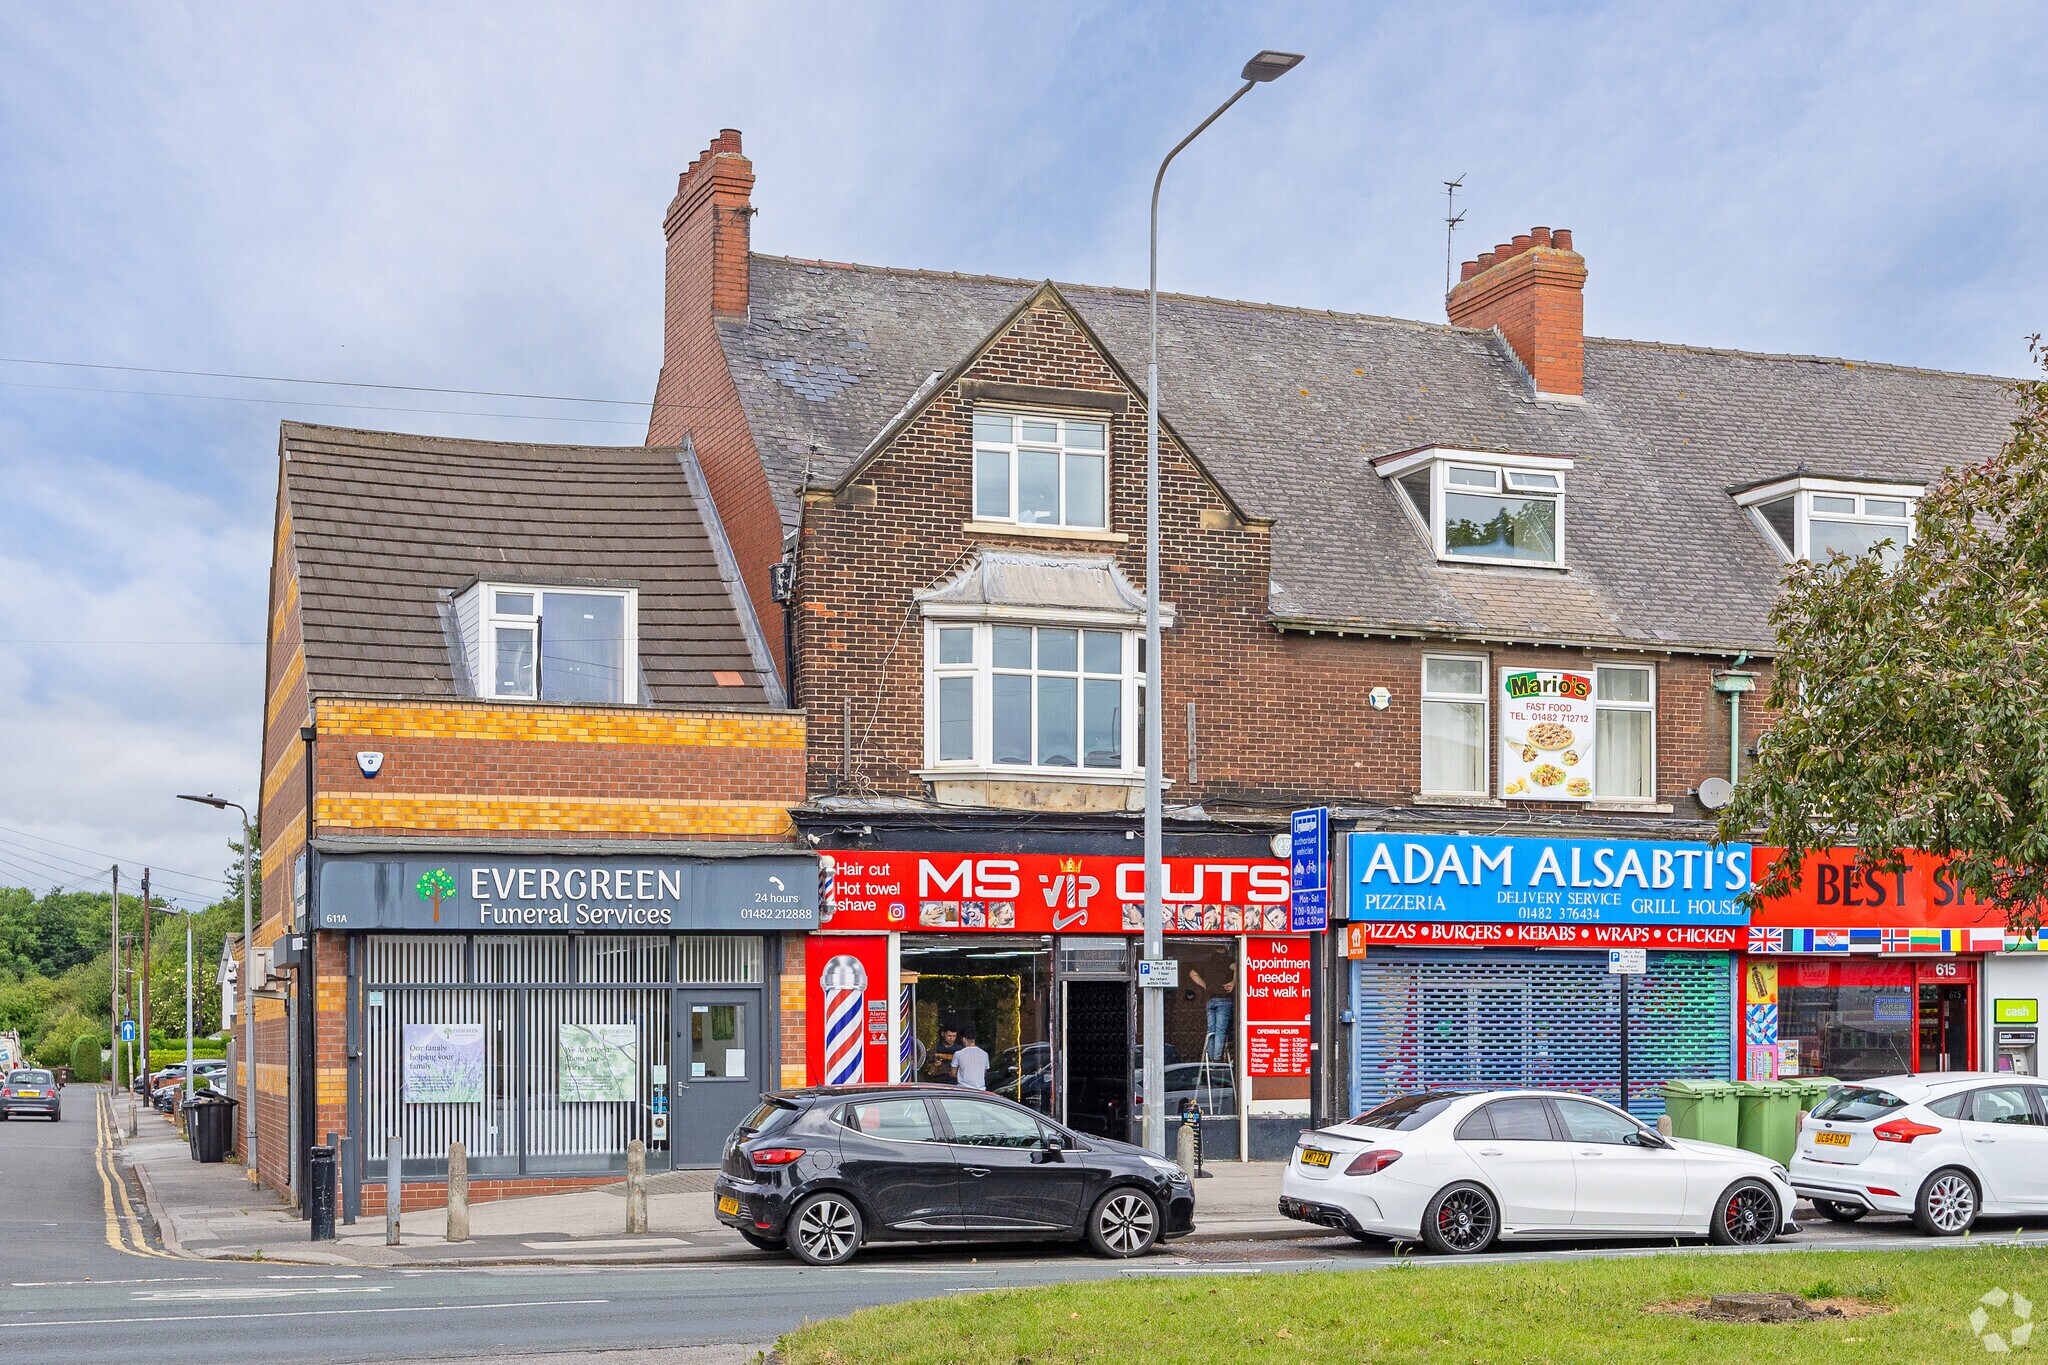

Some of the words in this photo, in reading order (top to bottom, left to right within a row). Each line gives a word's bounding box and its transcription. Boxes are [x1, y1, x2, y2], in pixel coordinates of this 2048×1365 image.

[1510, 675, 1587, 697] Mario's
[1525, 703, 1546, 711] FAST
[1548, 703, 1572, 712] FOOD
[1510, 712, 1529, 720] TEL:
[1532, 713, 1557, 722] 01482
[1561, 714, 1589, 723] 712712
[1294, 836, 1317, 846] authorised
[1296, 847, 1314, 856] vehicles
[836, 862, 864, 876] Hair
[869, 863, 890, 876] cut
[1361, 842, 1514, 886] ADAM
[1529, 847, 1748, 890] ALSABTI'S
[470, 867, 681, 900] EVERGREEN
[836, 881, 860, 895] Hot
[865, 882, 900, 895] towel
[918, 858, 1021, 899] MS
[1038, 874, 1100, 908] VIP
[1116, 862, 1291, 901] CUTS
[1294, 877, 1303, 887] taxi
[1817, 864, 1913, 907] BEST
[755, 893, 767, 903] 24
[769, 892, 799, 903] hours
[1497, 890, 1561, 905] DELIVERY
[1567, 891, 1622, 906] SERVICE
[837, 898, 877, 911] shave
[1365, 893, 1446, 912] PIZZERIA
[1631, 898, 1681, 915] GRILL
[1688, 899, 1741, 916] HOUSE
[326, 914, 348, 923] 611A
[479, 903, 570, 925] Funeral
[575, 904, 672, 925] Services
[741, 908, 772, 919] 01482
[774, 909, 813, 920] 212888
[1518, 906, 1552, 920] 01482
[1559, 907, 1601, 920] 376434
[1365, 923, 1416, 940] PIZZAS
[1431, 924, 1502, 942] BURGERS
[1518, 925, 1576, 941] KEBABS
[1595, 926, 1650, 942] WRAPS
[1667, 927, 1736, 943] CHICKEN
[1271, 942, 1288, 954] No
[1936, 963, 1956, 976] 615
[1257, 972, 1300, 983] needed
[1247, 986, 1269, 998] Just
[1272, 986, 1298, 998] walk
[2005, 1006, 2029, 1017] cash
[410, 1054, 436, 1062] helping
